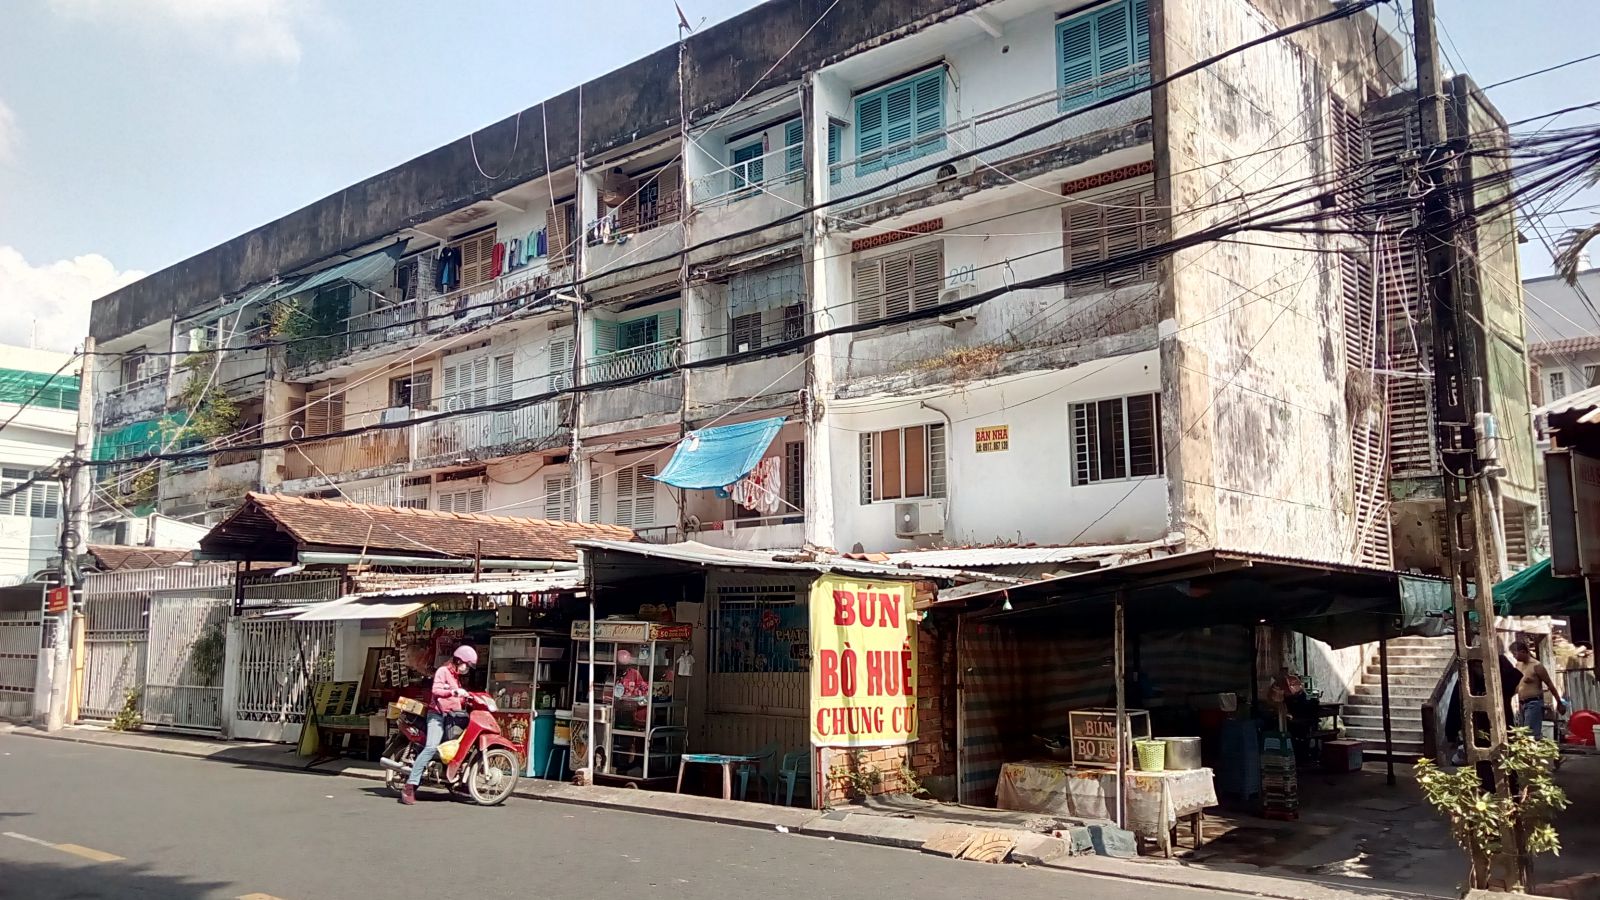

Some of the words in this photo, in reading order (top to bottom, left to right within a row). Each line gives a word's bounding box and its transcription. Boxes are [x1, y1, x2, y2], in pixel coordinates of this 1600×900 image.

[949, 263, 975, 286] 201
[832, 584, 901, 629] BÚN
[820, 641, 857, 697] BÒ
[866, 635, 914, 697] HUẾ
[816, 706, 884, 737] CHUNG
[891, 704, 916, 734] CƯ
[1085, 716, 1113, 737] BÚN
